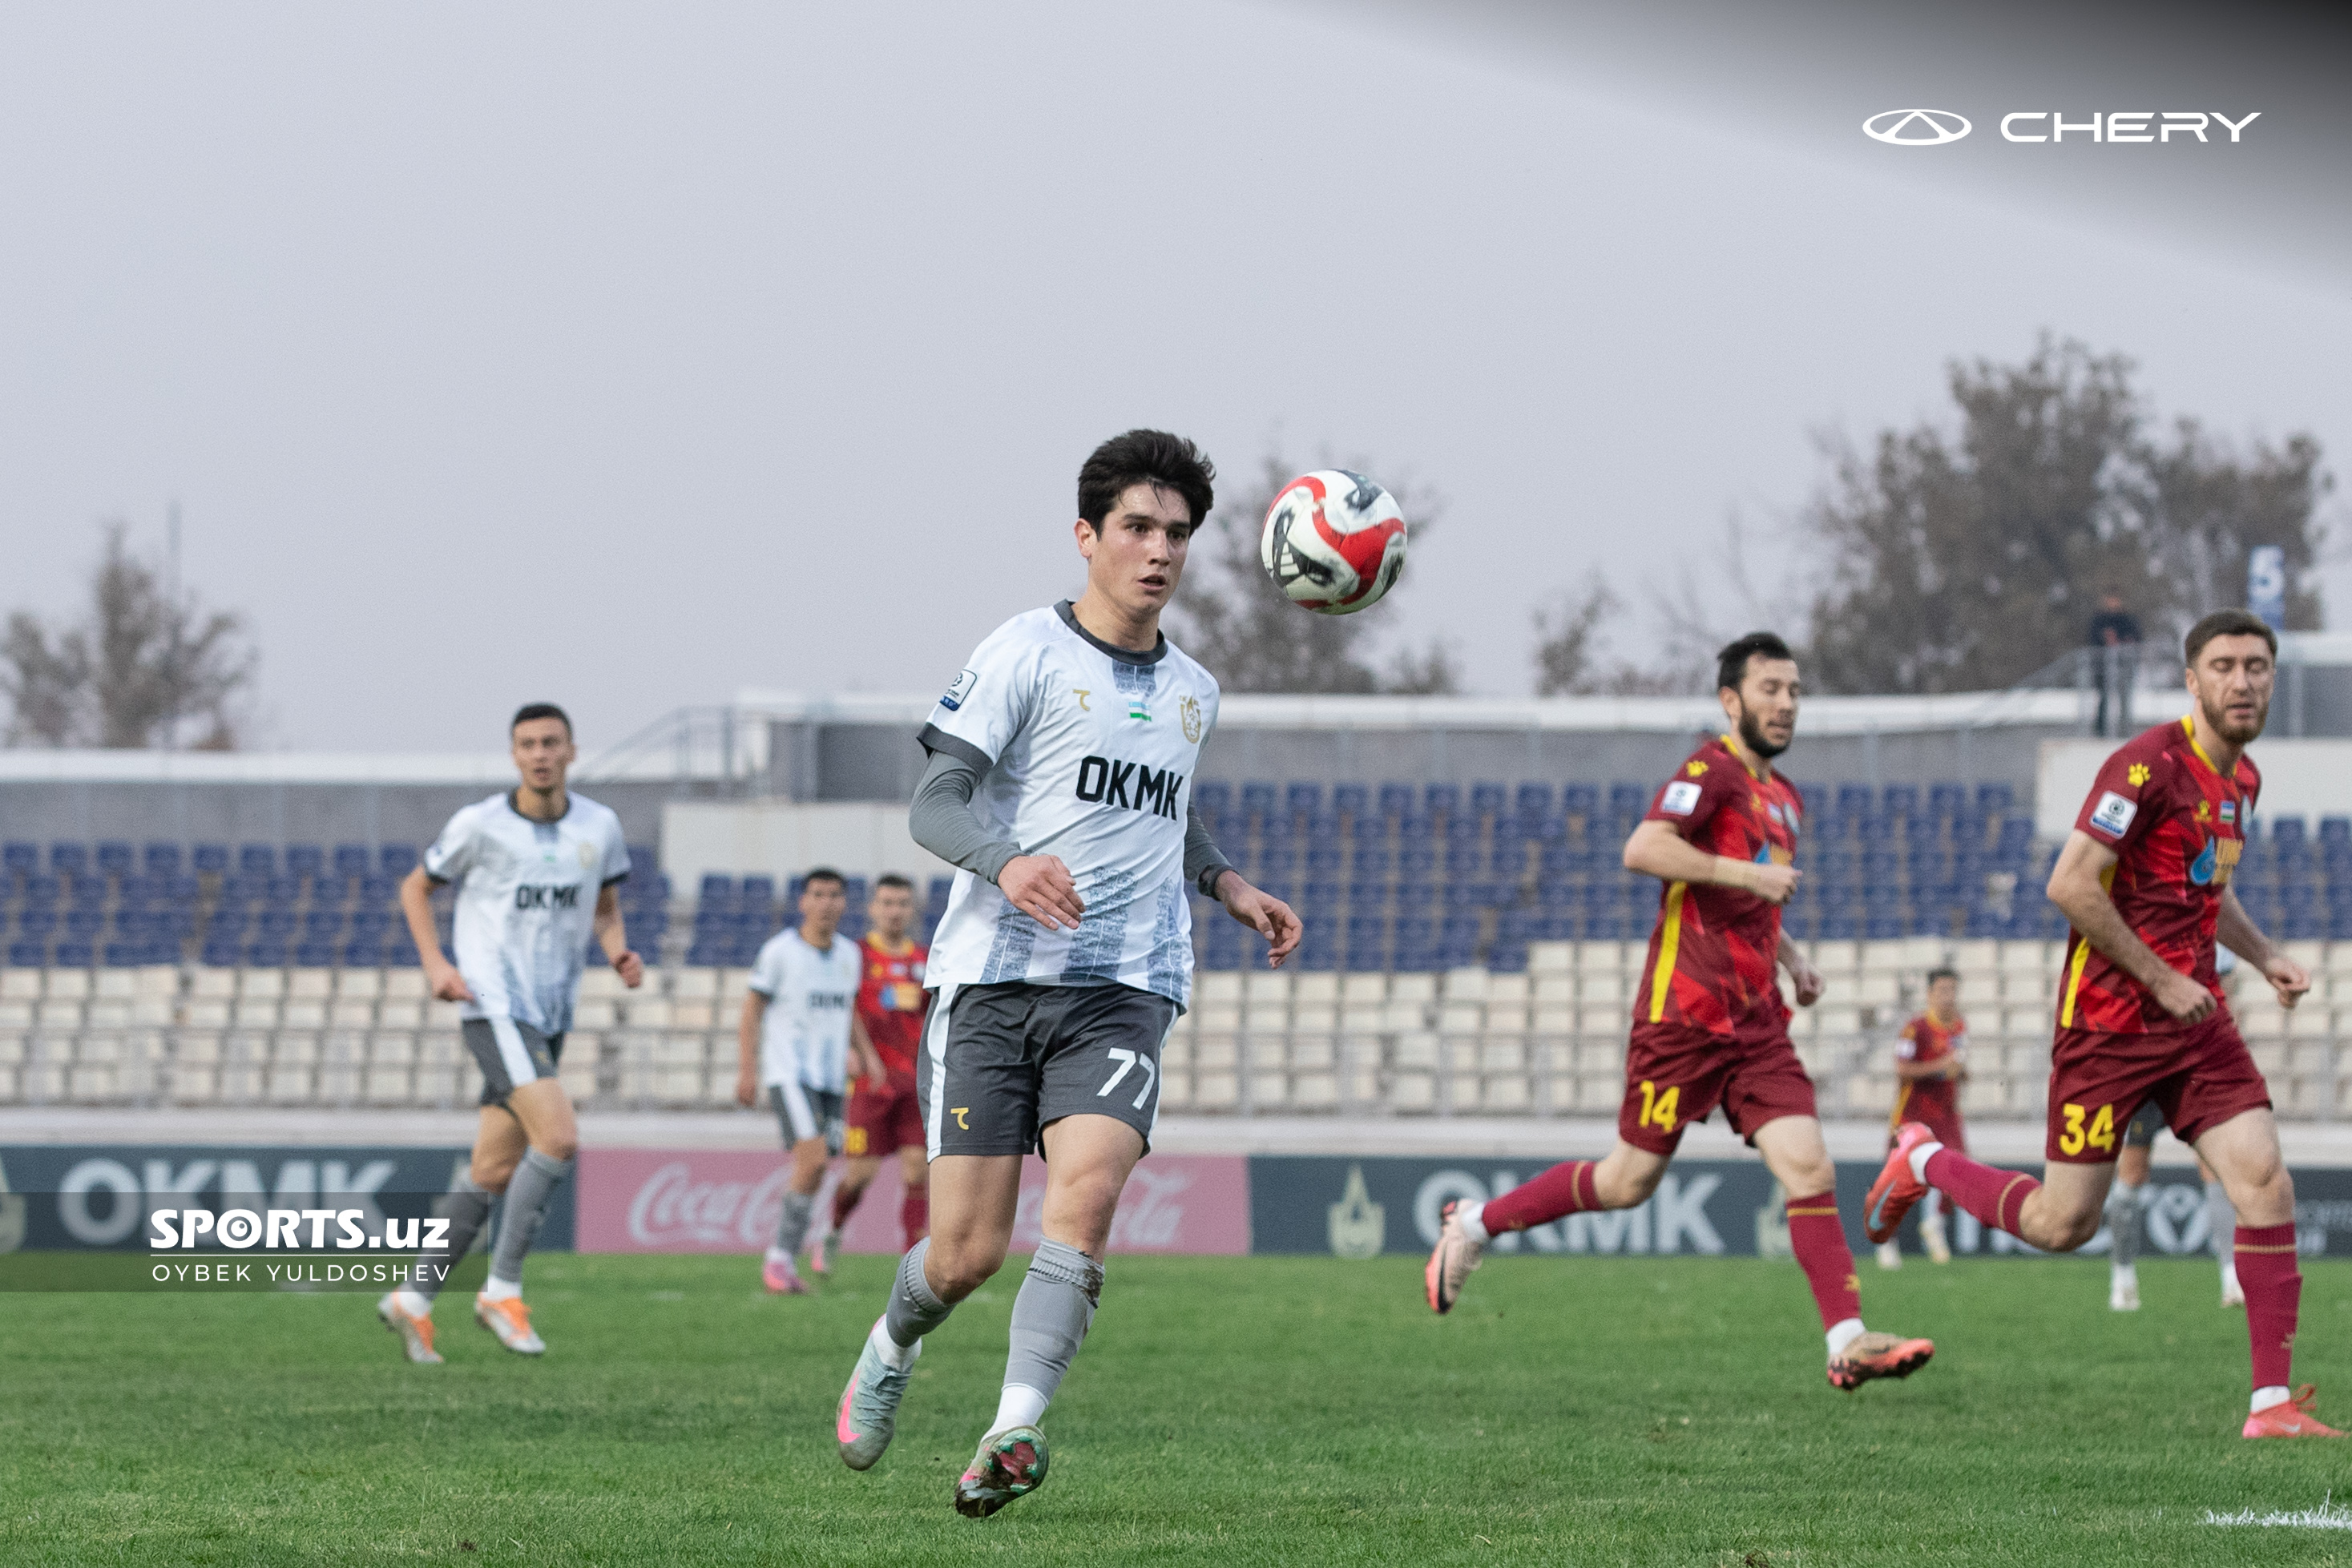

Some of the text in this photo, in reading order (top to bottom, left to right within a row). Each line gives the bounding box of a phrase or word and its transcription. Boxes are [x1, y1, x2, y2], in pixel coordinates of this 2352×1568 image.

[1075, 755, 1184, 821] OKMK
[515, 884, 579, 910] OKMK
[1096, 1047, 1156, 1110] 77
[1639, 1079, 1680, 1134] 14
[2059, 1102, 2115, 1156] 34
